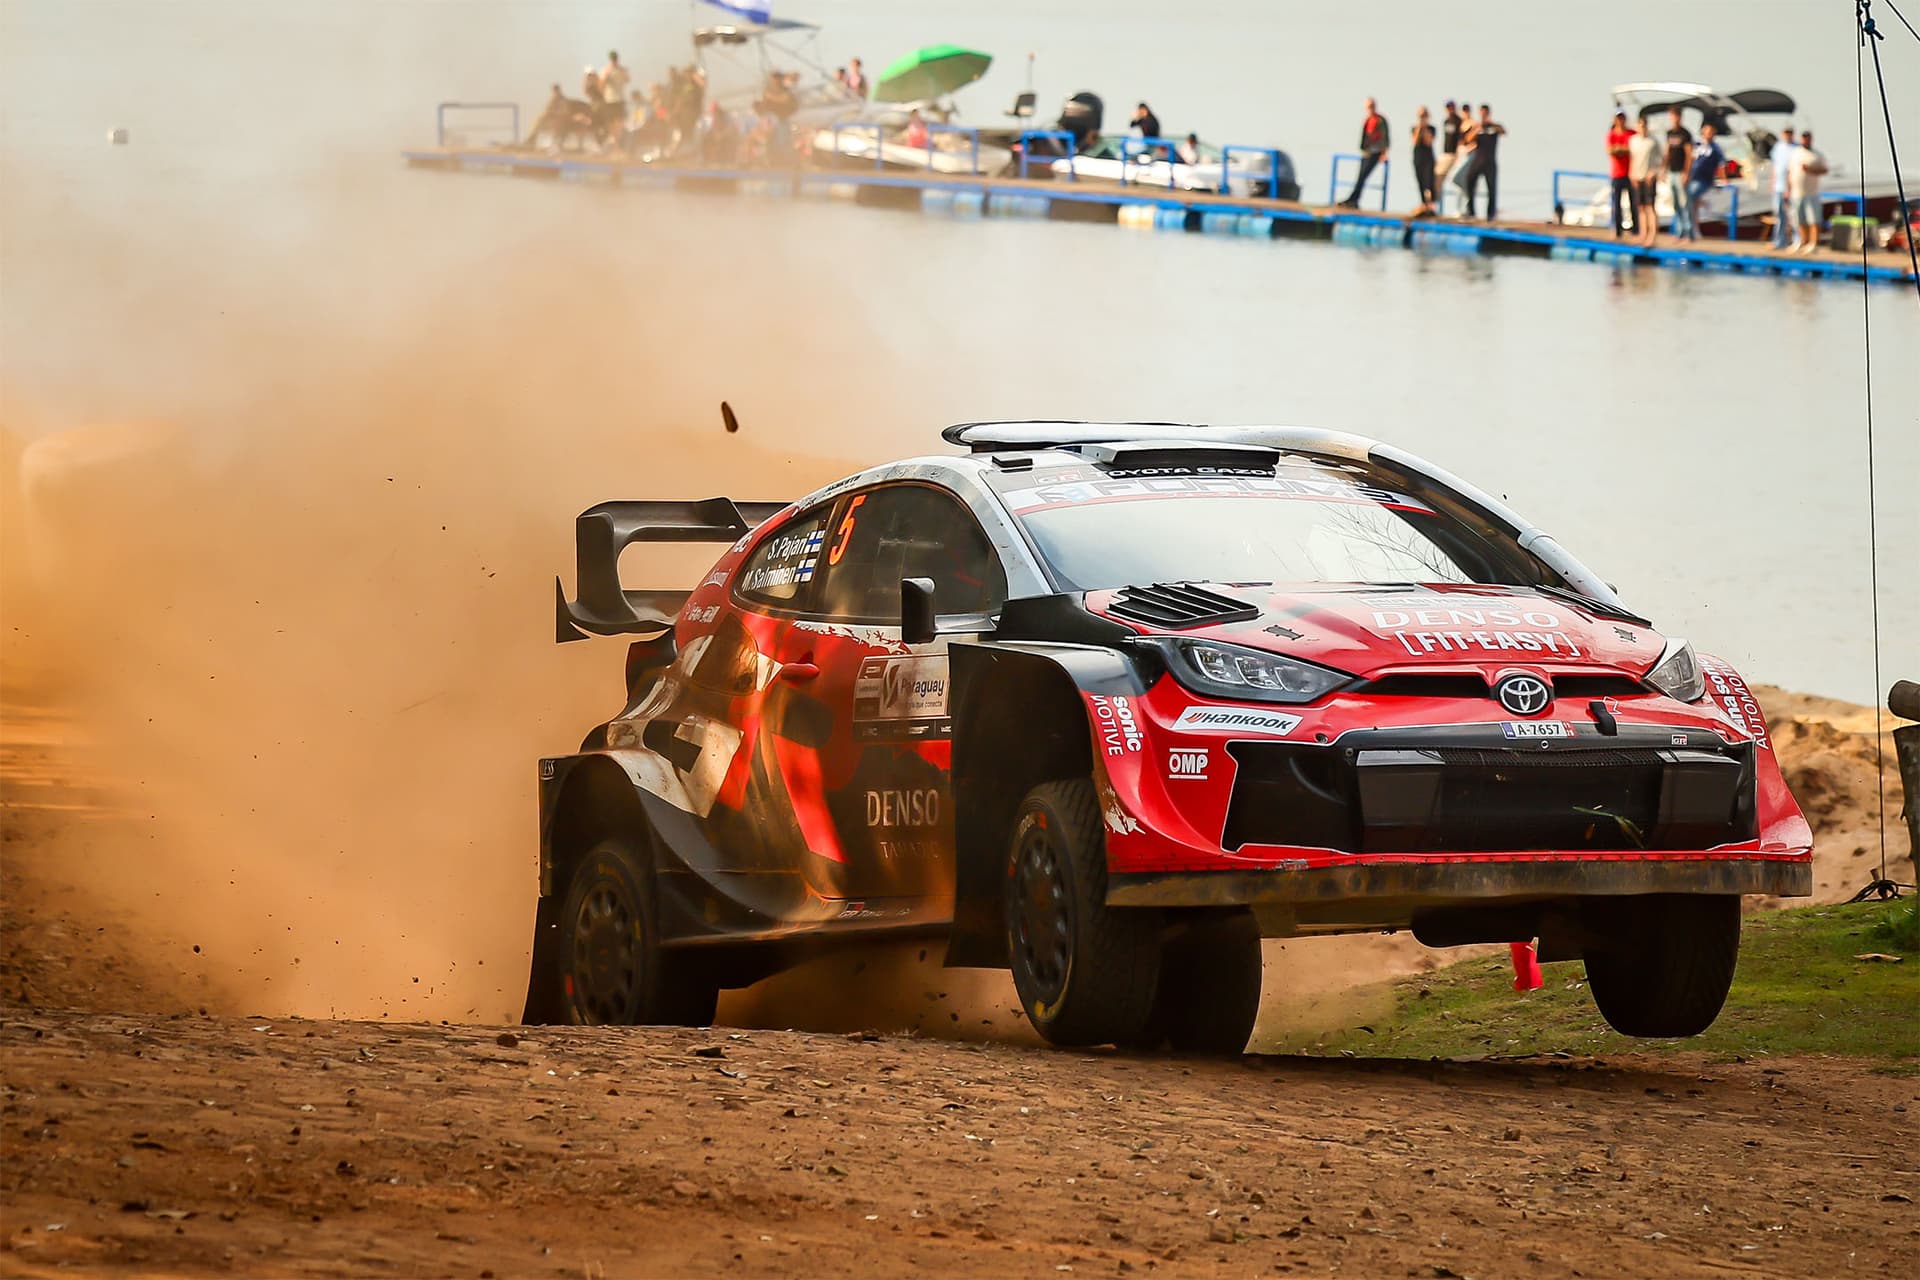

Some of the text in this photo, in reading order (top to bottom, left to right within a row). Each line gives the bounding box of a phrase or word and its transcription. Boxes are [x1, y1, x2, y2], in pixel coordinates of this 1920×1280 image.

[828, 494, 868, 566] 5
[1371, 610, 1560, 629] DENSO
[1112, 696, 1144, 752] sonic
[1518, 724, 1560, 735] A-7657
[1169, 753, 1208, 774] OMP
[866, 788, 939, 827] DENSO
